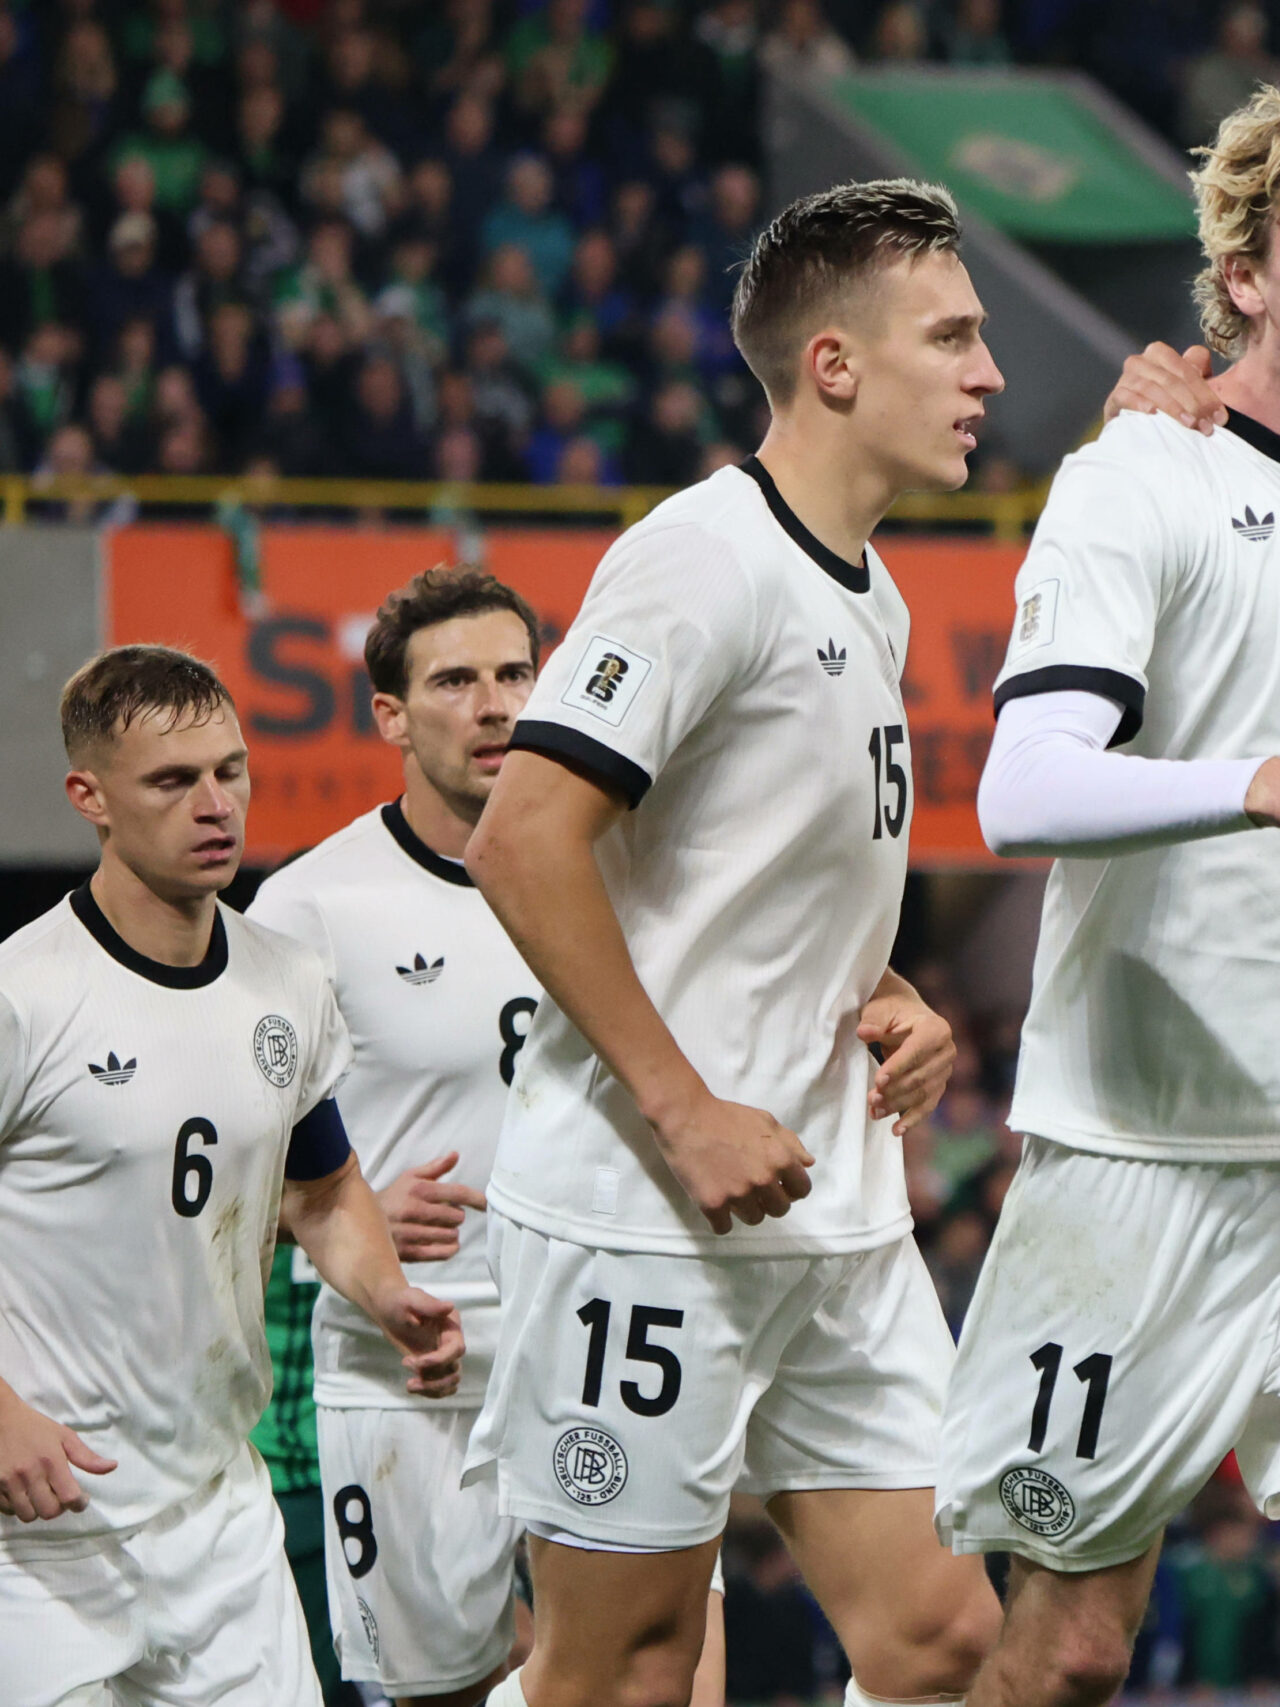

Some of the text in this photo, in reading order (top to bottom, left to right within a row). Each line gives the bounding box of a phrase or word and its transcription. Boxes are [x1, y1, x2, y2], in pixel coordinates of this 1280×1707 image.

[868, 725, 907, 840] 15
[499, 997, 538, 1087] 8
[171, 1117, 218, 1218] 6
[577, 1298, 684, 1417] 15
[1028, 1343, 1113, 1460] 11
[557, 1432, 581, 1488] DEUTSCHER
[577, 1491, 592, 1502] 125
[333, 1484, 378, 1580] 8
